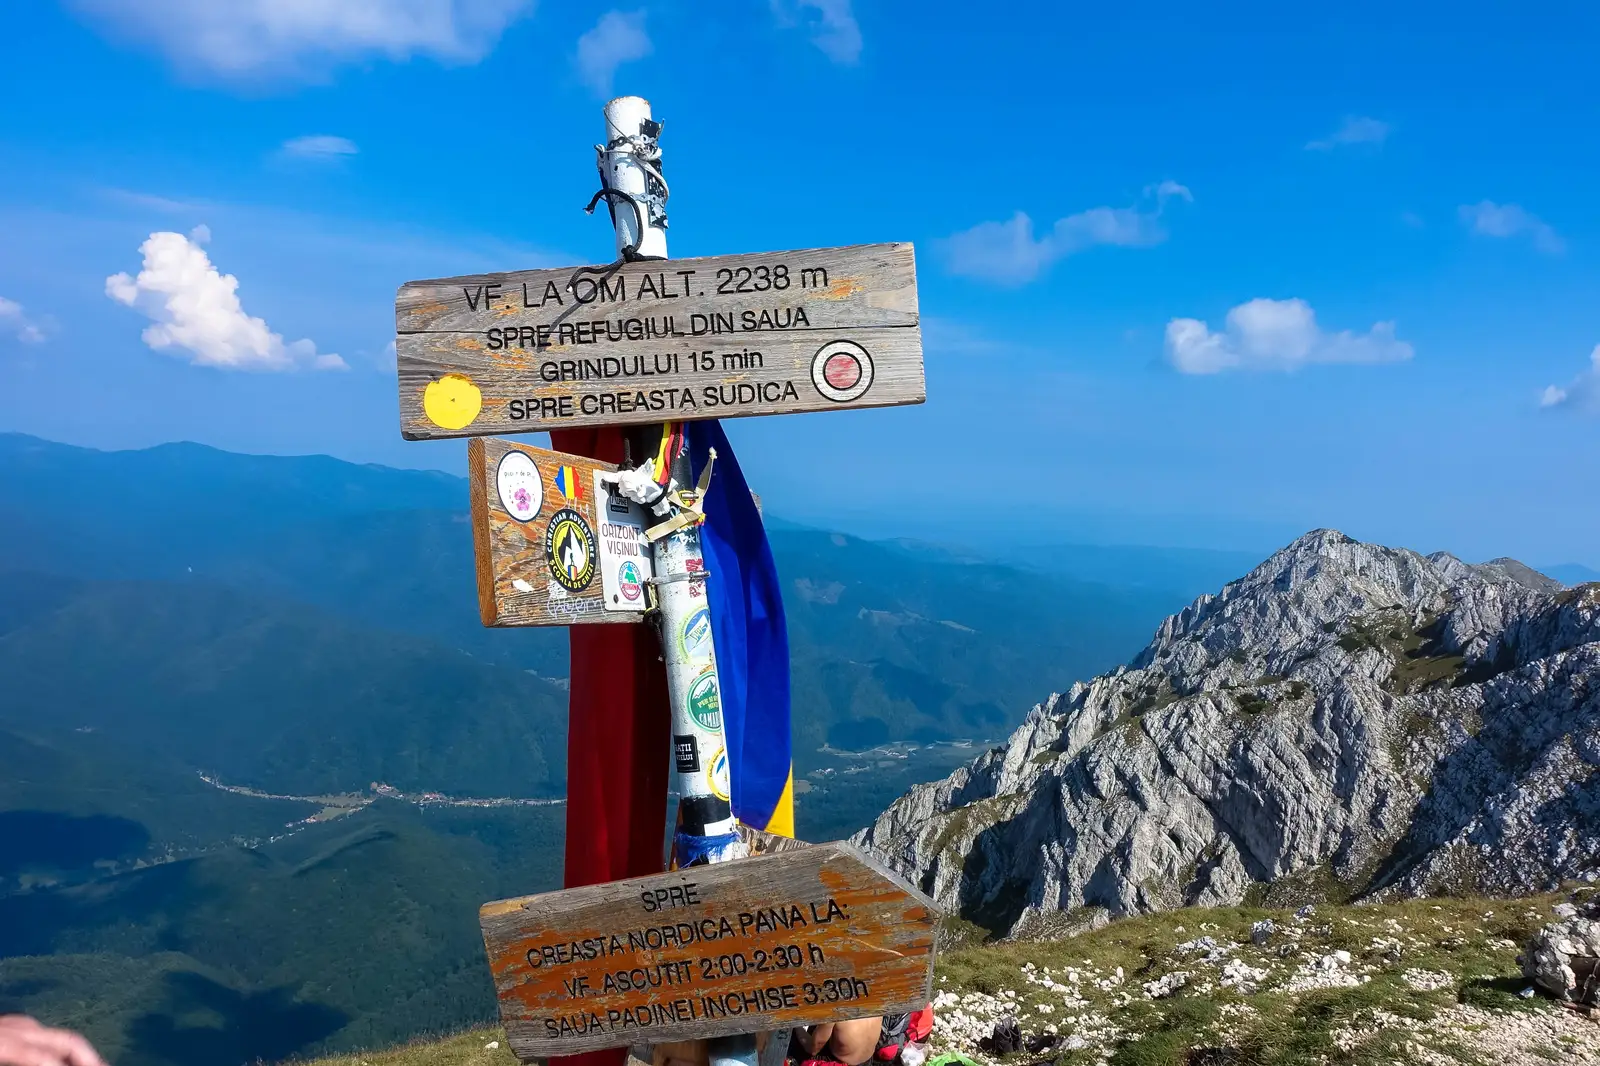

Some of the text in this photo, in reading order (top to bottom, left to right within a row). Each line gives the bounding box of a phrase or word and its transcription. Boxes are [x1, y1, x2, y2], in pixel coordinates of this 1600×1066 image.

[463, 264, 828, 312] VF. LA OM ALT. 2238 m
[486, 306, 811, 350] SPRE REFUGIUL DIN SAUA
[539, 348, 764, 382] GRINDULUI 15 min
[508, 380, 800, 421] SPRE CREASTA SUDICA
[547, 512, 595, 558] CHRISTIAN ADVENTURE
[601, 522, 640, 541] ORIZONT
[606, 540, 638, 558] VIȘINIU
[641, 883, 701, 912] SPRE
[526, 898, 850, 969] CREASTA NORDICA PANA LA:
[563, 942, 825, 1000] VF. ASCUTIT 2:00-2:30 h
[544, 976, 869, 1039] SAUA PADINEI INCHISE 3:30h
